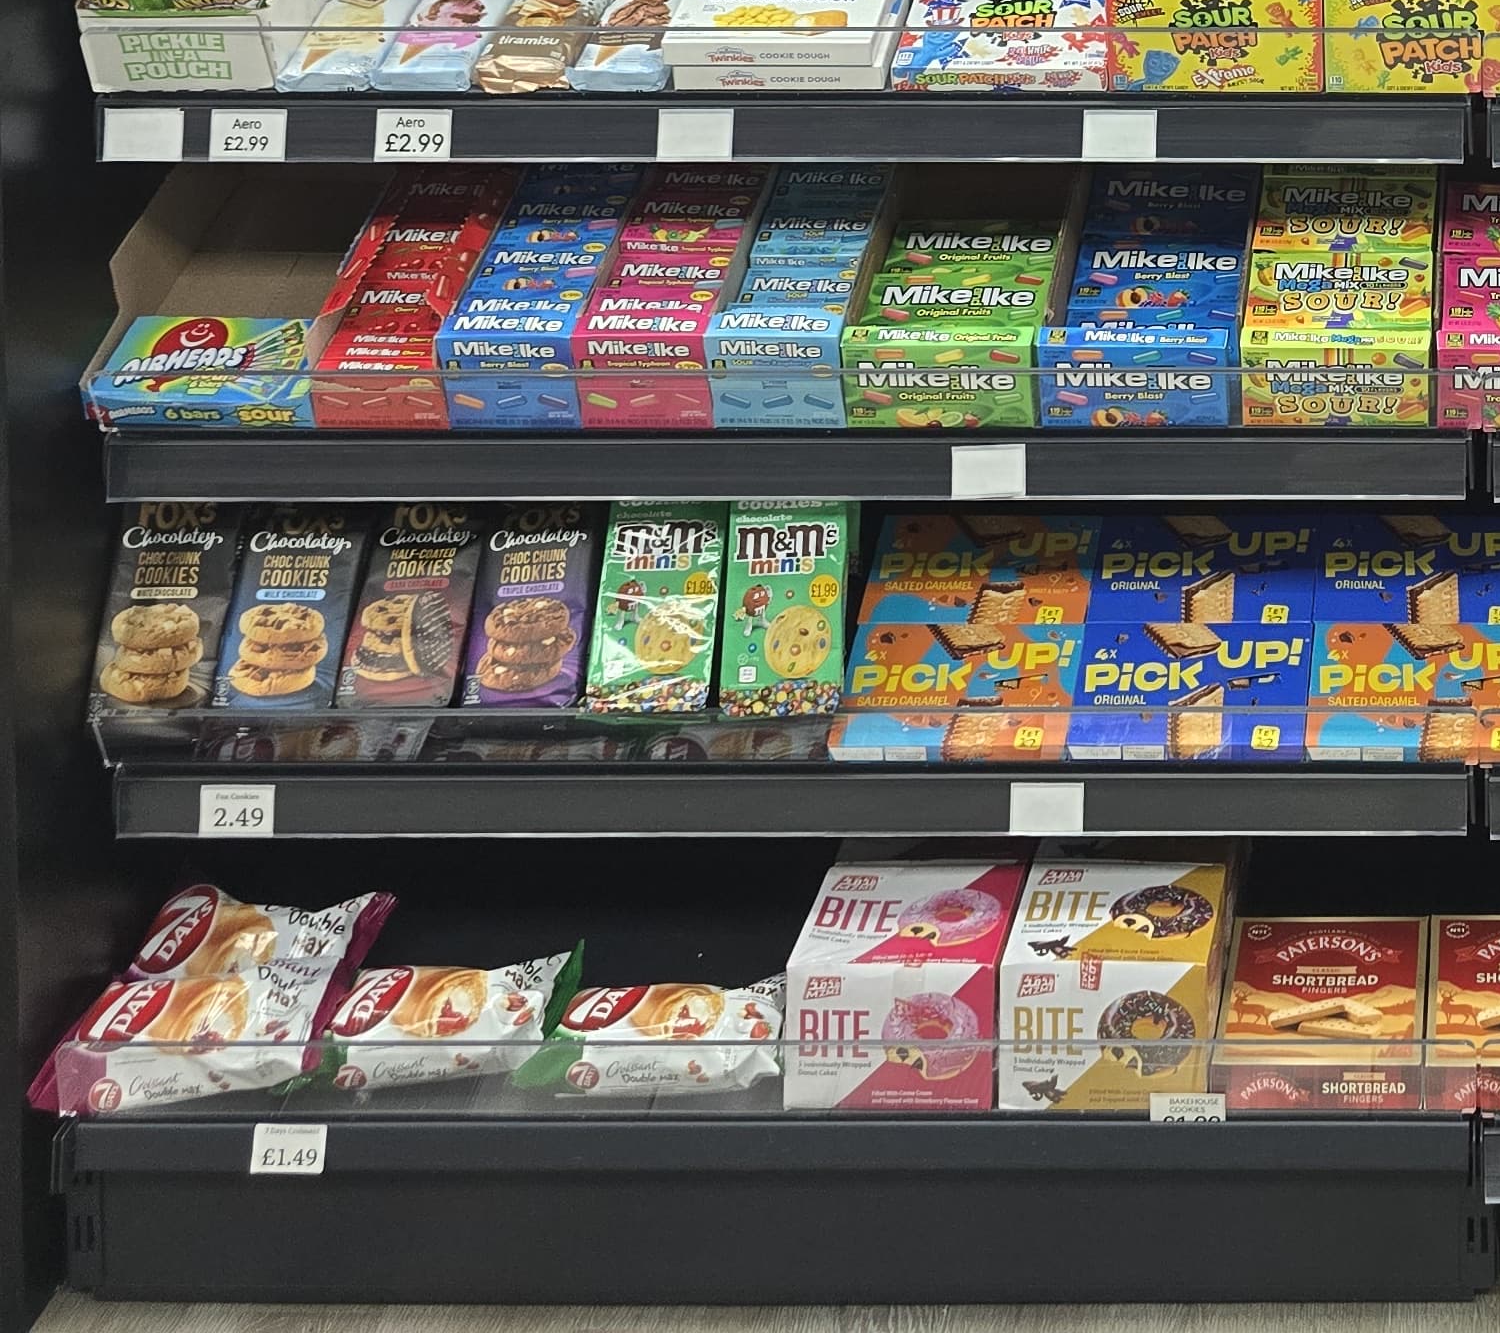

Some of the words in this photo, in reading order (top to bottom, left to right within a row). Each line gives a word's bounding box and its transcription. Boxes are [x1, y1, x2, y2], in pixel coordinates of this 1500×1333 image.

[498, 34, 560, 47] tiramisu
[233, 117, 261, 130] Aero
[223, 135, 269, 153] £2.99
[384, 133, 444, 154] £2.99
[1135, 272, 1162, 281] Berry
[1165, 272, 1190, 280] Blast
[1284, 291, 1403, 310] SOUR!
[916, 309, 957, 317] Original
[115, 347, 246, 386] AIRHEADS
[165, 409, 174, 421] 6
[179, 408, 222, 421] bars
[238, 407, 293, 425] sour
[250, 531, 351, 554] Chocolatey
[264, 555, 293, 569] CHOC
[295, 554, 331, 569] CHUNK
[390, 548, 456, 561] HALF-COATED
[750, 557, 815, 576] minis
[260, 569, 328, 588] COOKIES
[811, 583, 838, 598] £1.99
[856, 696, 897, 706] SALTED
[901, 695, 949, 706] CARAMEL
[1093, 694, 1147, 705] ORIGINAL
[213, 807, 264, 827] 2.49
[1024, 891, 1109, 921] BITE
[1276, 936, 1382, 963] PATERSON'S
[1272, 974, 1378, 986] SHORTBREAD
[1302, 986, 1347, 994] FINGERS
[1169, 1098, 1219, 1106] BAKEHOUSE
[262, 1147, 318, 1169] £1.49
